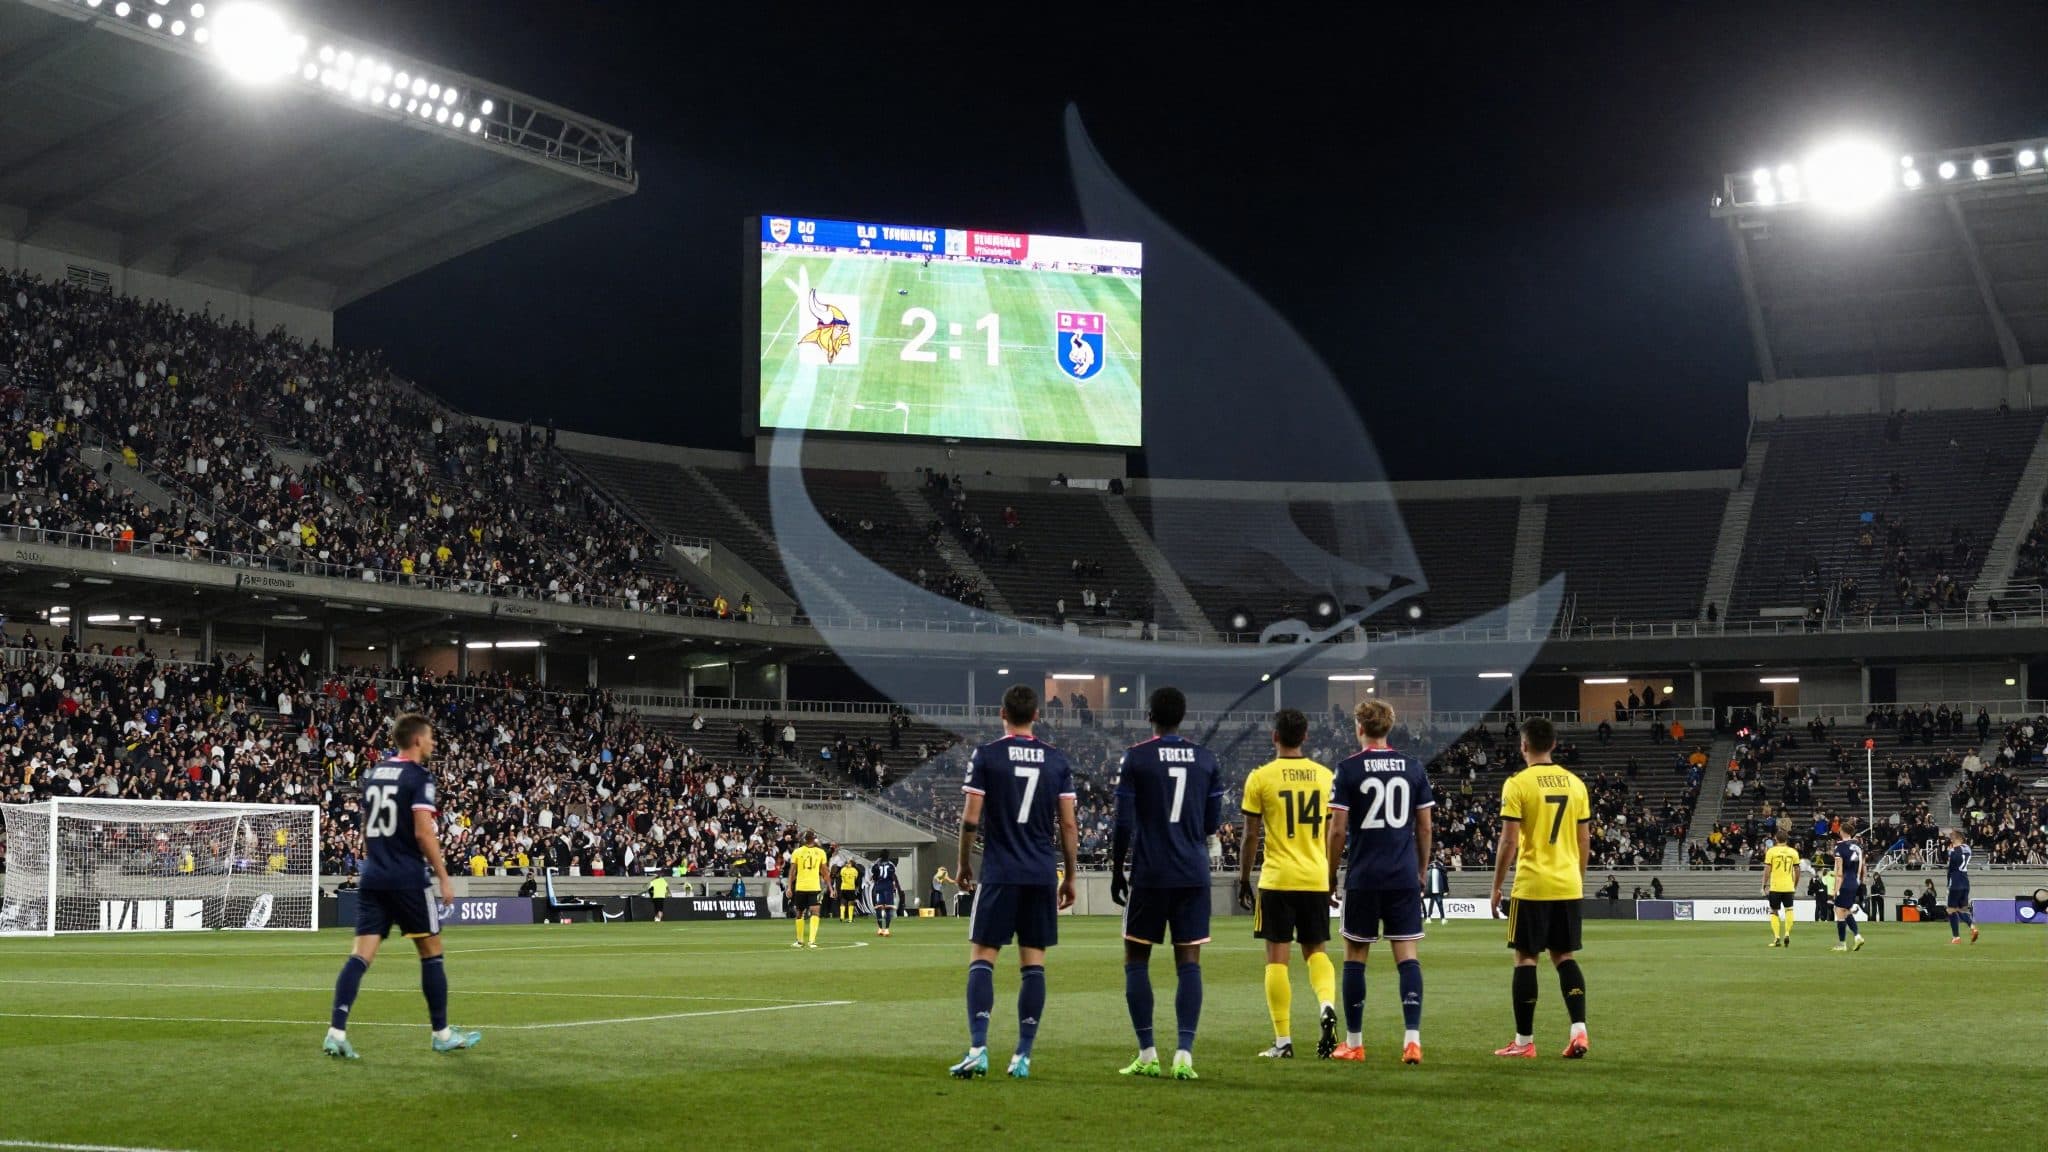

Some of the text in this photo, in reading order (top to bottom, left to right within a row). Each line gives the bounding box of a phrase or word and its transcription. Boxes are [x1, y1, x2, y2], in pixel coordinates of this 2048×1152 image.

[899, 307, 1001, 367] 2:1
[365, 785, 398, 838] 25
[1014, 766, 1040, 824] 7
[1168, 767, 1187, 823] 7
[1278, 790, 1323, 839] 14
[1359, 776, 1410, 829] 20
[1544, 795, 1569, 845] 7
